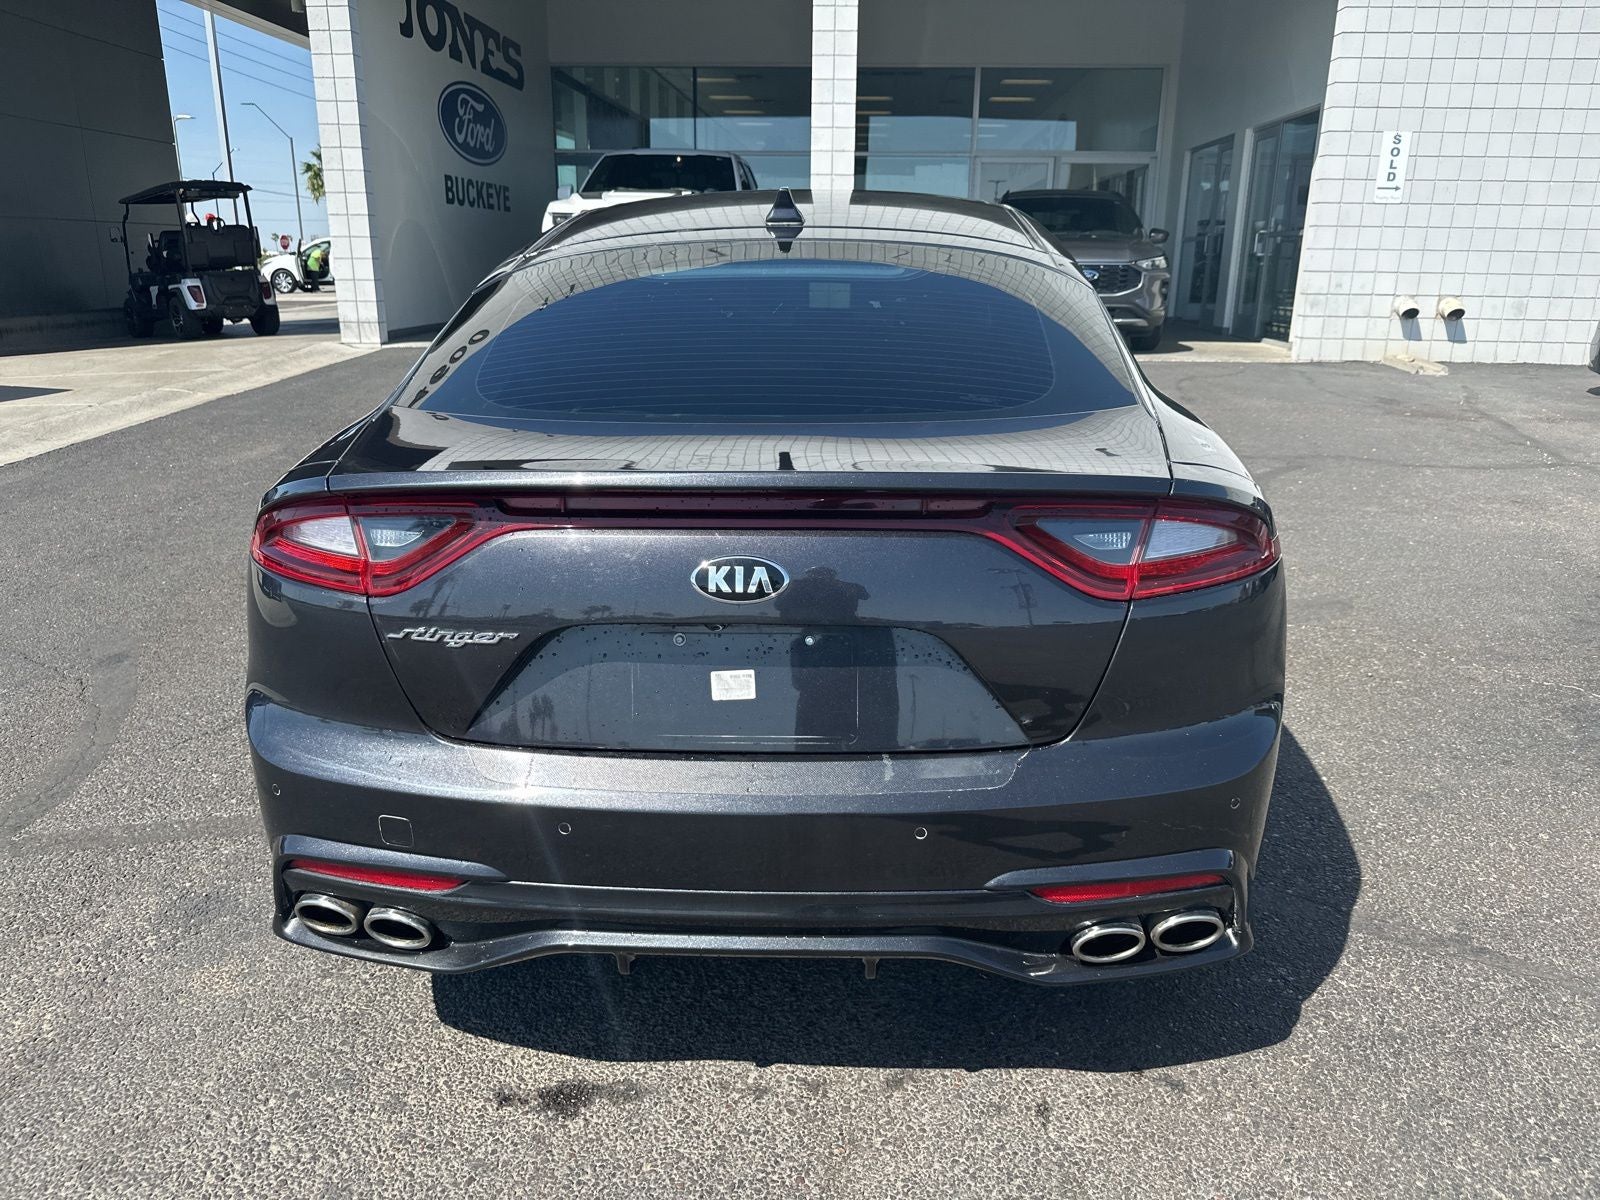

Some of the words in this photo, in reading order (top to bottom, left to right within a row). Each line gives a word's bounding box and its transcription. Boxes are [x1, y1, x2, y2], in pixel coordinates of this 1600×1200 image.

[399, 0, 525, 91] JONES
[454, 93, 495, 153] Ford
[1386, 133, 1403, 182] SOLD
[444, 174, 511, 212] BUCKEYE
[707, 565, 774, 593] KIA
